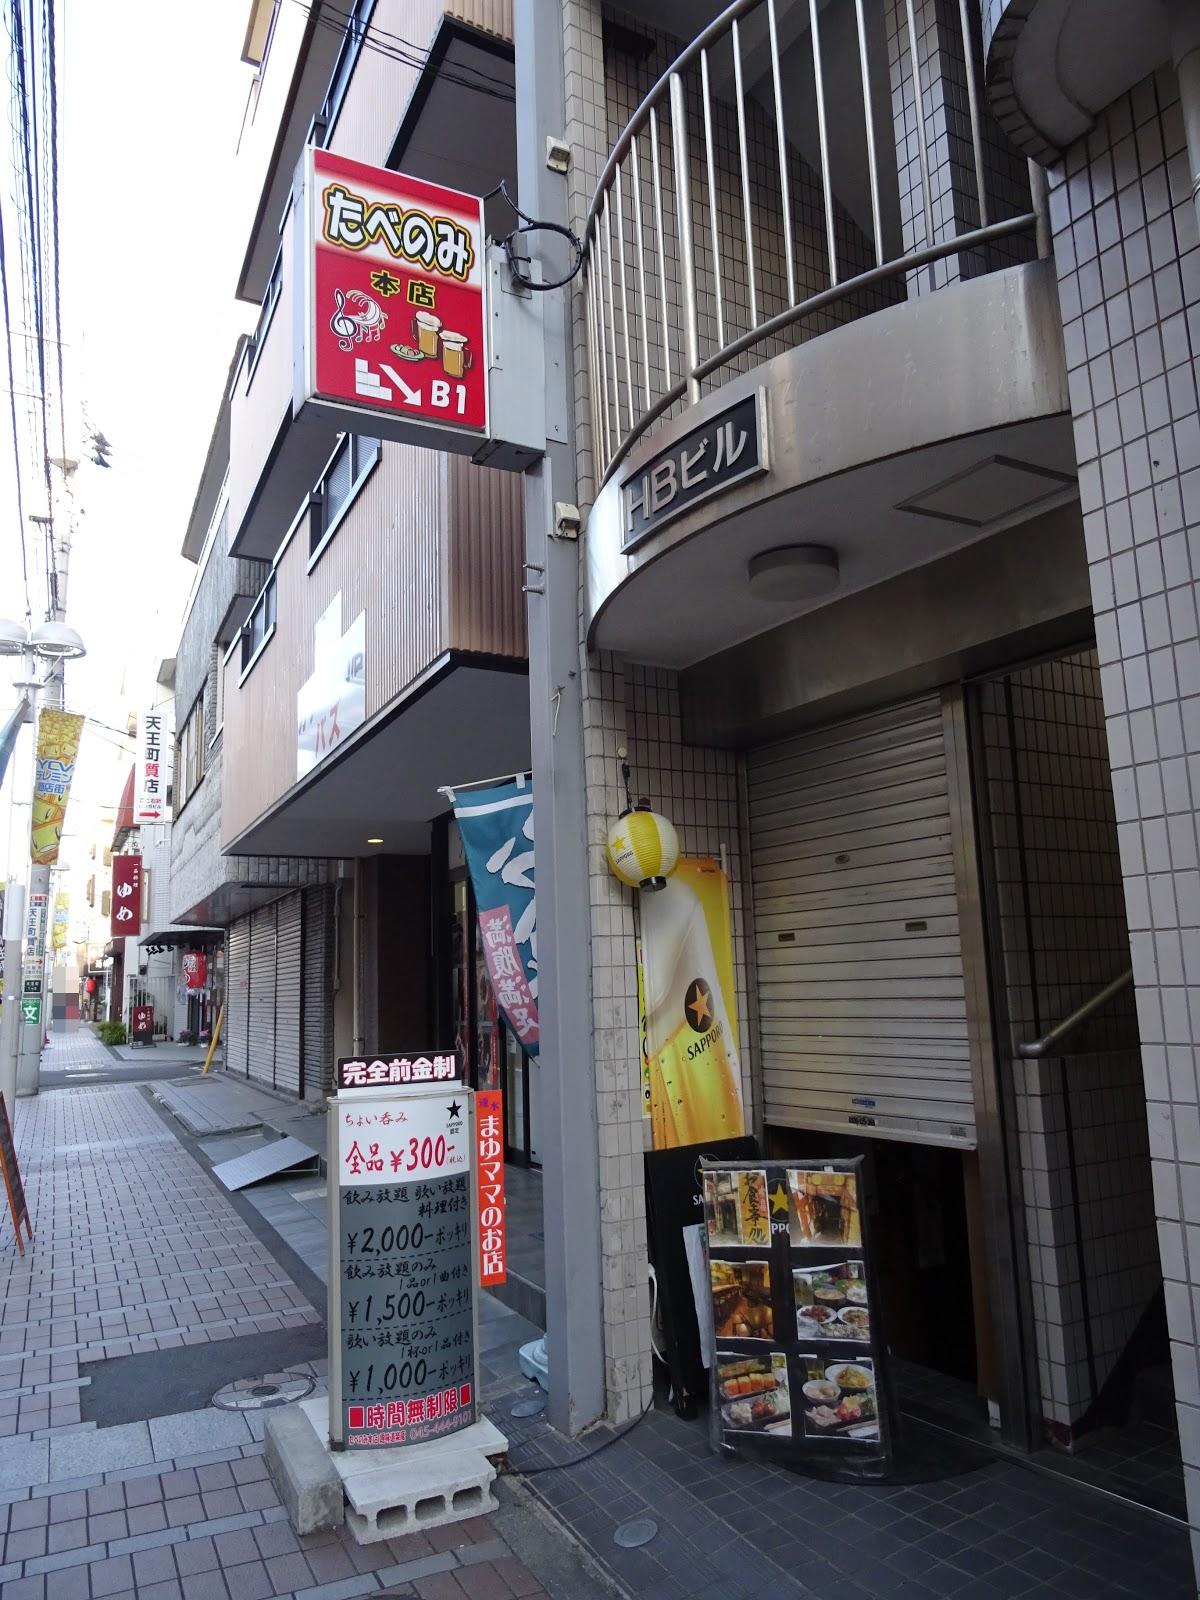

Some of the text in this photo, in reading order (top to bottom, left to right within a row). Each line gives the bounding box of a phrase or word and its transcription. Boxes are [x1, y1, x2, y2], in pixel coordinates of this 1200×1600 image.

[322, 183, 474, 281] たべのみ
[370, 270, 435, 309] 本店
[431, 380, 467, 415] B1
[625, 421, 748, 532] HBビル
[37, 759, 74, 772] YCV
[144, 715, 162, 794] 天王町質店
[116, 882, 133, 921] ゆめ
[687, 1022, 724, 1061] SAPPORO
[343, 1055, 456, 1085] 完全前金制
[344, 1111, 408, 1127] ちょい呑み
[343, 1186, 410, 1205] 飲み放題
[479, 1115, 504, 1276] まゆママのお店
[344, 1258, 437, 1280] 飲み放題のみ
[346, 1326, 437, 1350] 歌い放題のみ
[366, 1388, 458, 1429] 時間無制限
